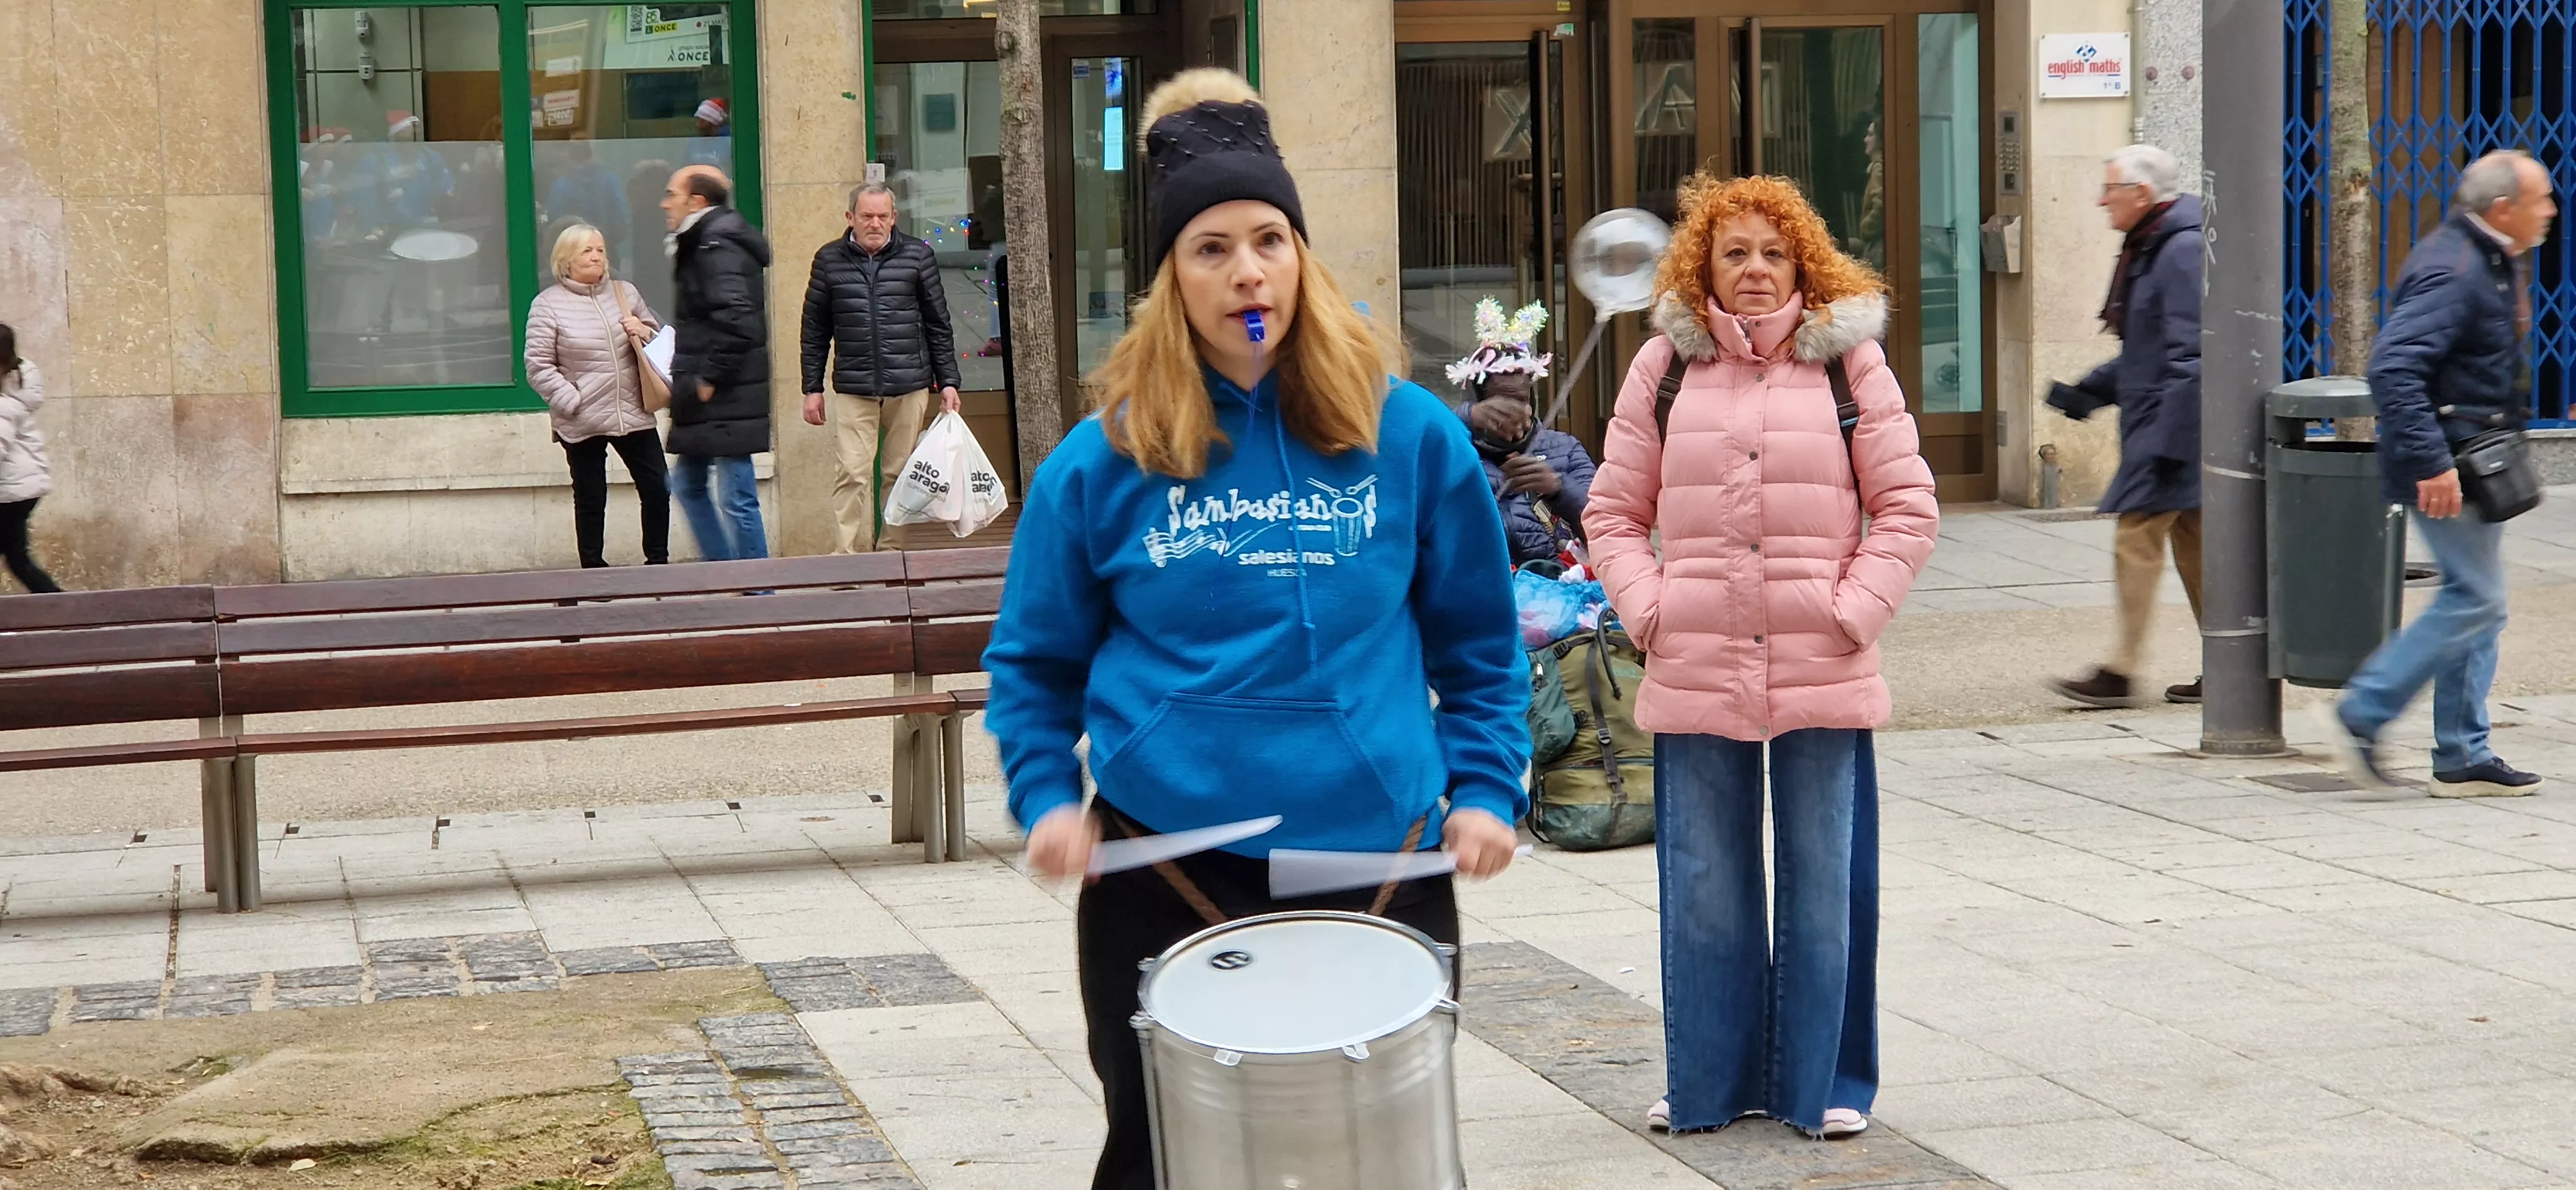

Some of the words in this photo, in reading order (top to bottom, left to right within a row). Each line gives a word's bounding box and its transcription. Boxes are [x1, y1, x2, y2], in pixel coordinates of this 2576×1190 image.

[654, 23, 677, 32] ONCE
[678, 52, 708, 61] ONCE
[2048, 60, 2084, 80] english
[2090, 59, 2121, 73] maths
[914, 460, 940, 478] alto
